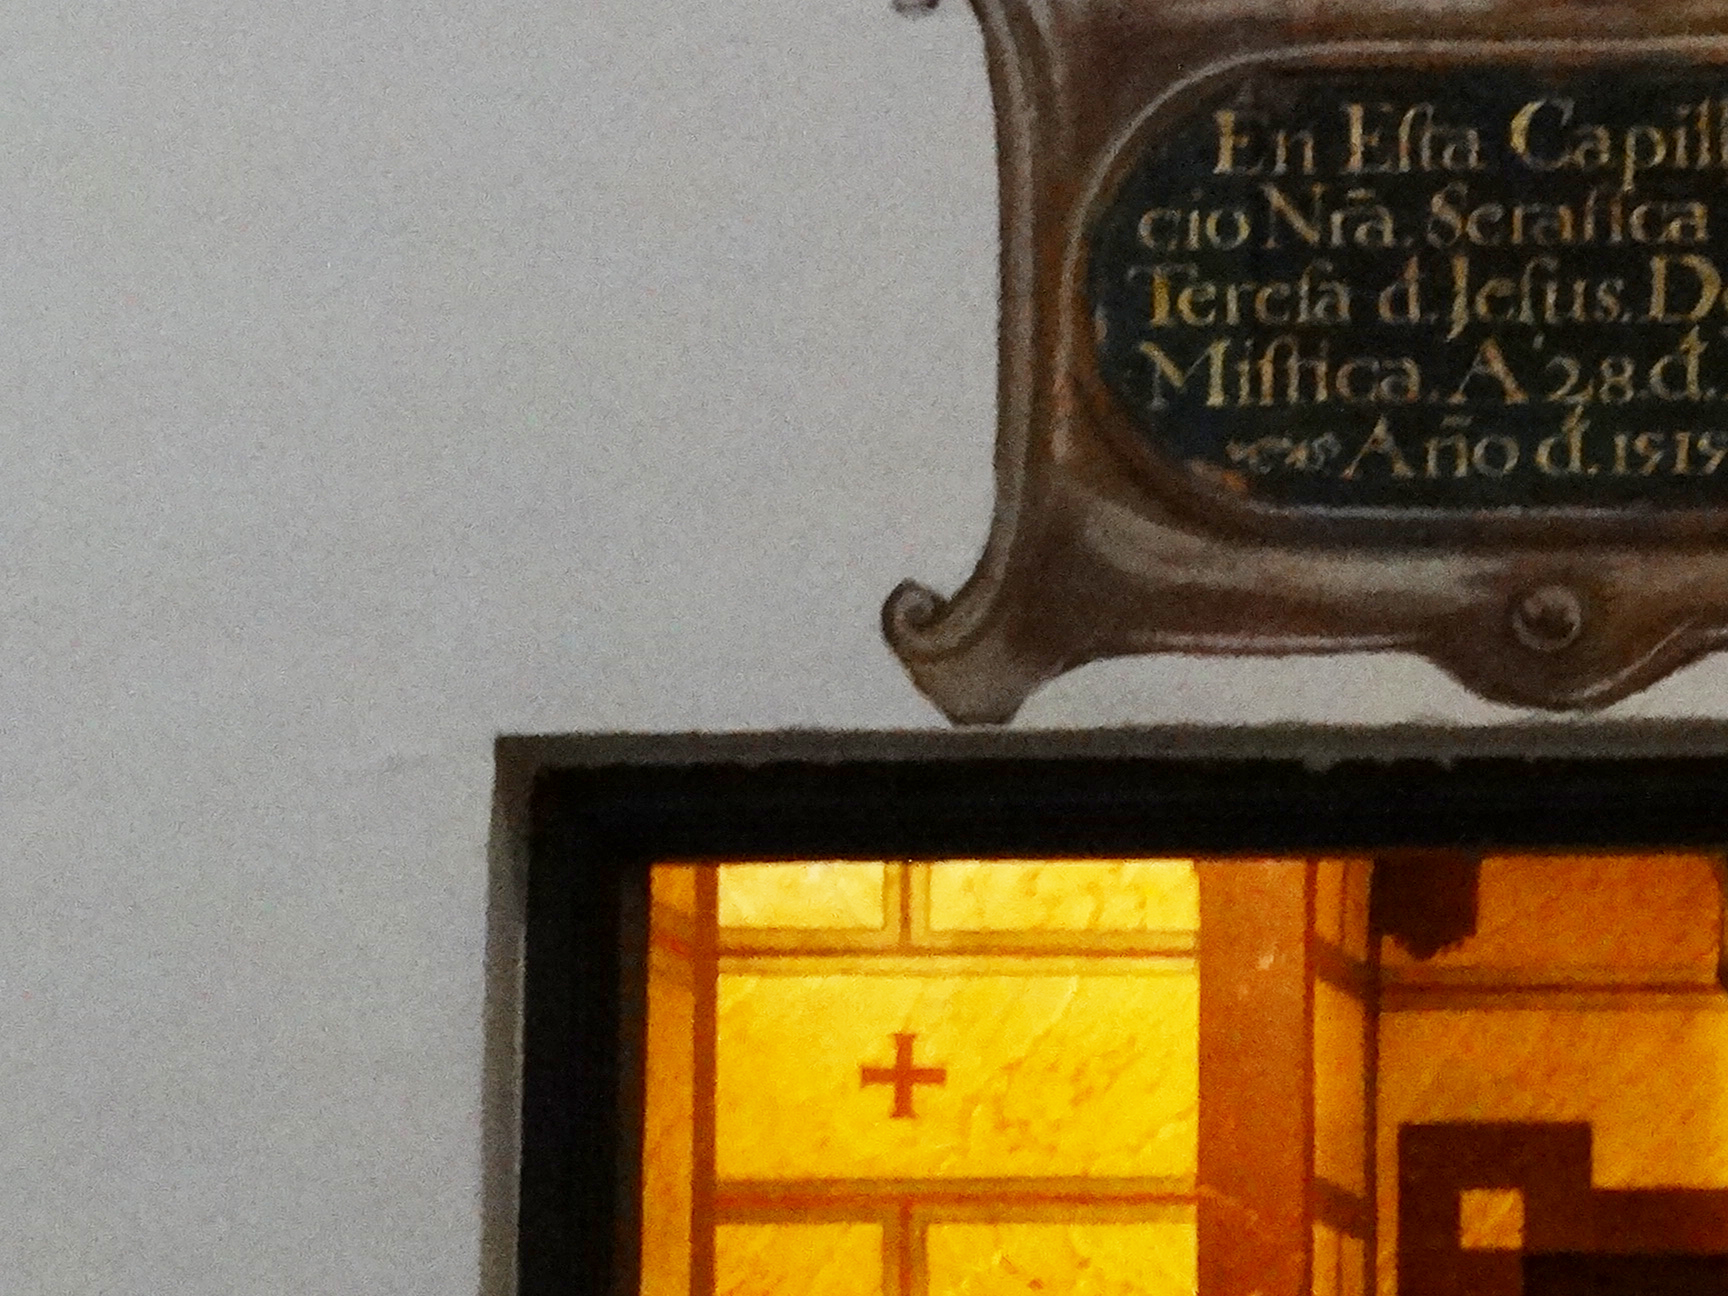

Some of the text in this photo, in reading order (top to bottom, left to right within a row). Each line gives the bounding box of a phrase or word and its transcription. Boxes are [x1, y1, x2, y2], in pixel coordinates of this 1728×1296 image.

[1212, 106, 1318, 176] En
[1136, 206, 1252, 252] cio
[1341, 414, 1520, 480] Año
